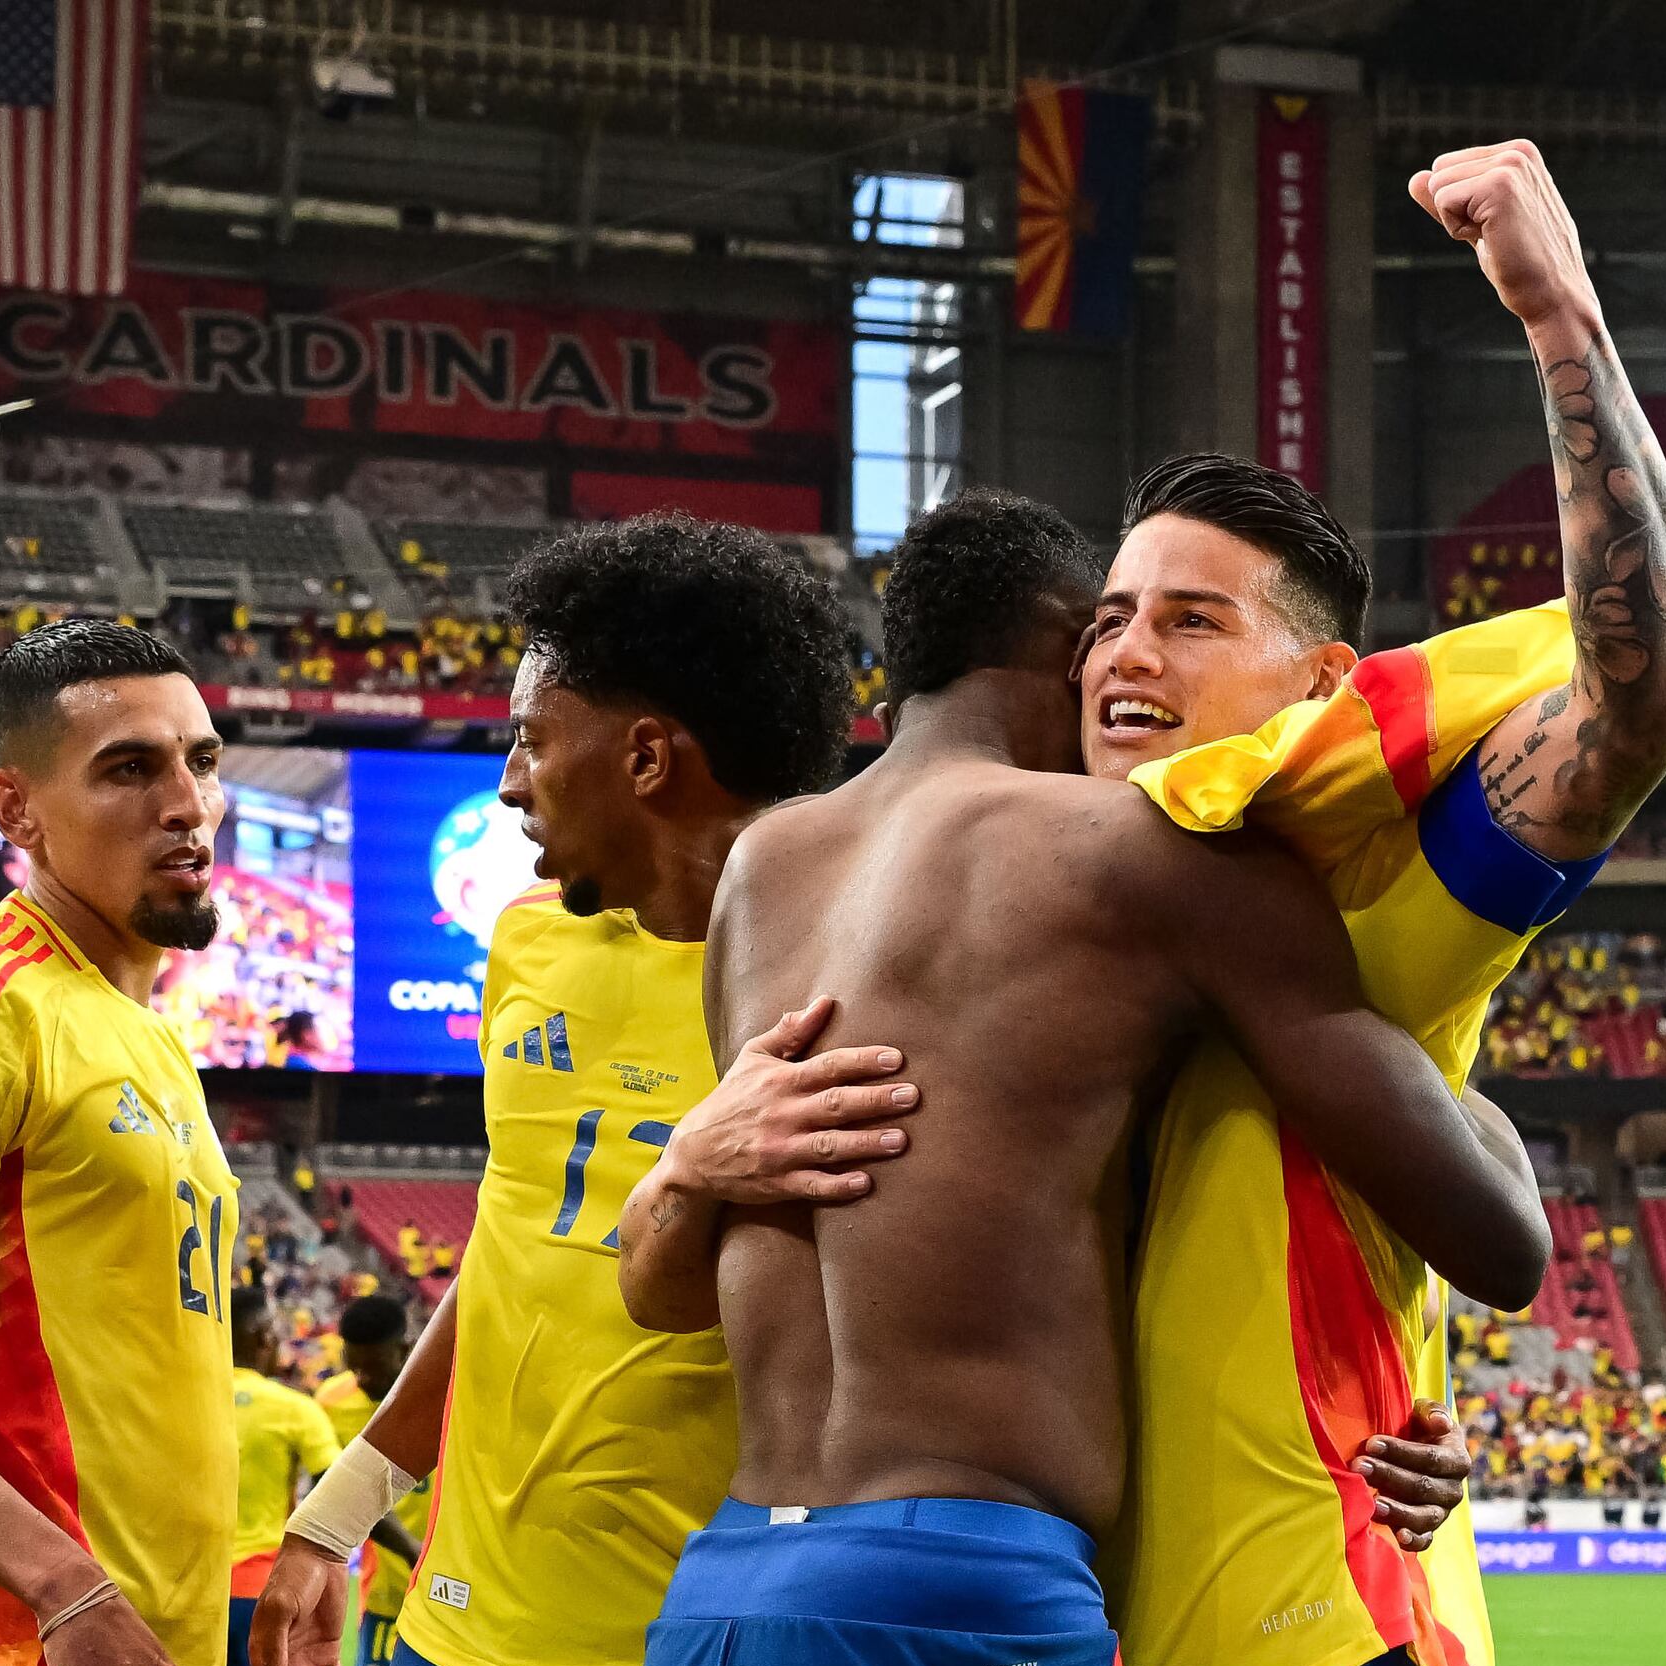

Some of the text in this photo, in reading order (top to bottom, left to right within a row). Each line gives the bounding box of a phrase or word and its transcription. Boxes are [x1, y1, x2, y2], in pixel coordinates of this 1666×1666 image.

[388, 979, 481, 1013] COPA
[176, 1178, 223, 1326] 21
[1476, 1541, 1556, 1570] pegar
[1261, 1599, 1334, 1635] HEAT.RDY
